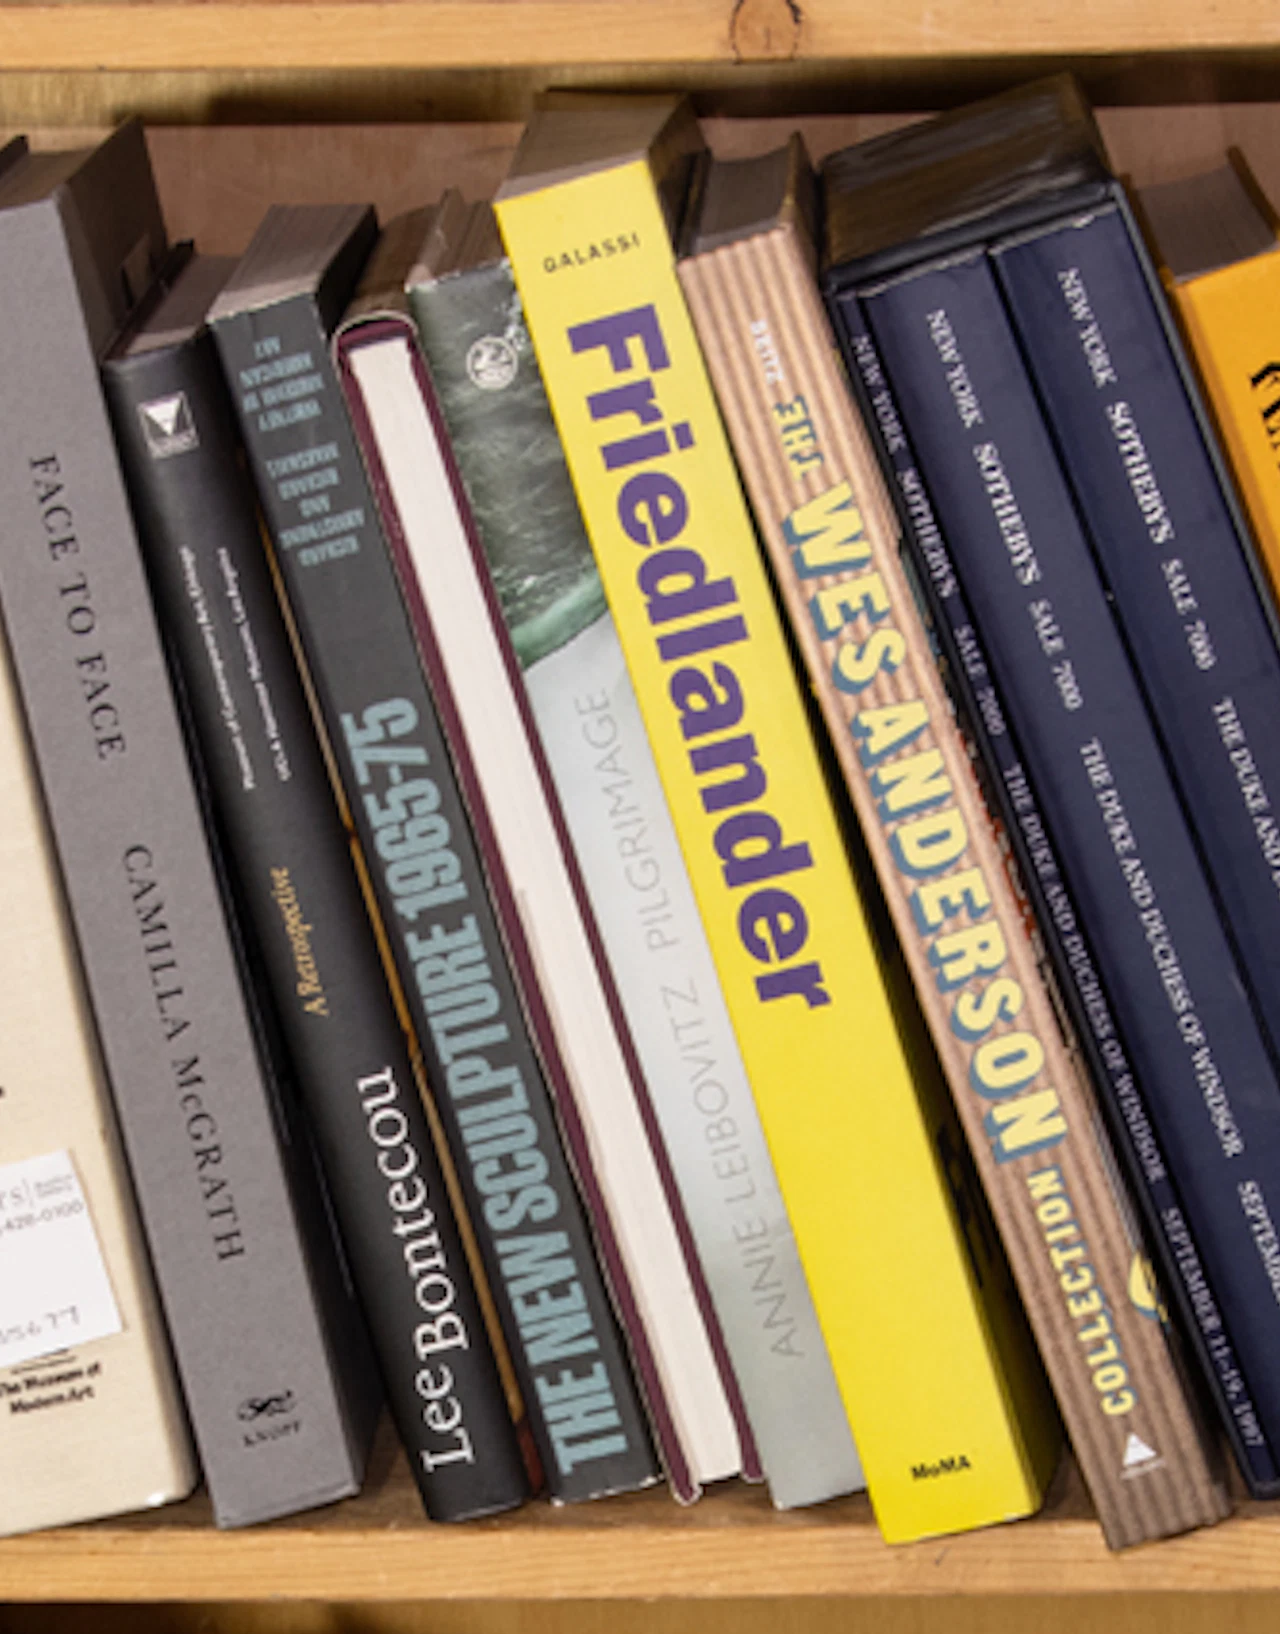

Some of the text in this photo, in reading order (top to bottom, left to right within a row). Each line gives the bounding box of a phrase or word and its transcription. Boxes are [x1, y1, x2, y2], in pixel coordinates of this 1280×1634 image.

[542, 231, 642, 274] GALASSI
[1058, 267, 1094, 321] NEW
[1078, 320, 1118, 389] YORK
[29, 452, 127, 760] FACE TO FACE
[566, 303, 832, 1010] Friedlander
[1160, 558, 1199, 616] SALE
[1212, 697, 1245, 749] THE
[1228, 747, 1270, 815] DUKE
[574, 691, 681, 952] PILGRIMAGE
[772, 394, 1137, 1417] THE WES ANDERSON COLLECTION
[270, 866, 322, 998] Retrospective
[124, 844, 246, 1264] CAMILLA McGRATH
[341, 697, 627, 1474] THE NEW SCULPTURE 1965-75
[660, 976, 806, 1360] ANNIE LEIBOVITZ
[357, 1066, 475, 1472] Lee Bontecou
[910, 1454, 972, 1481] MoMA
